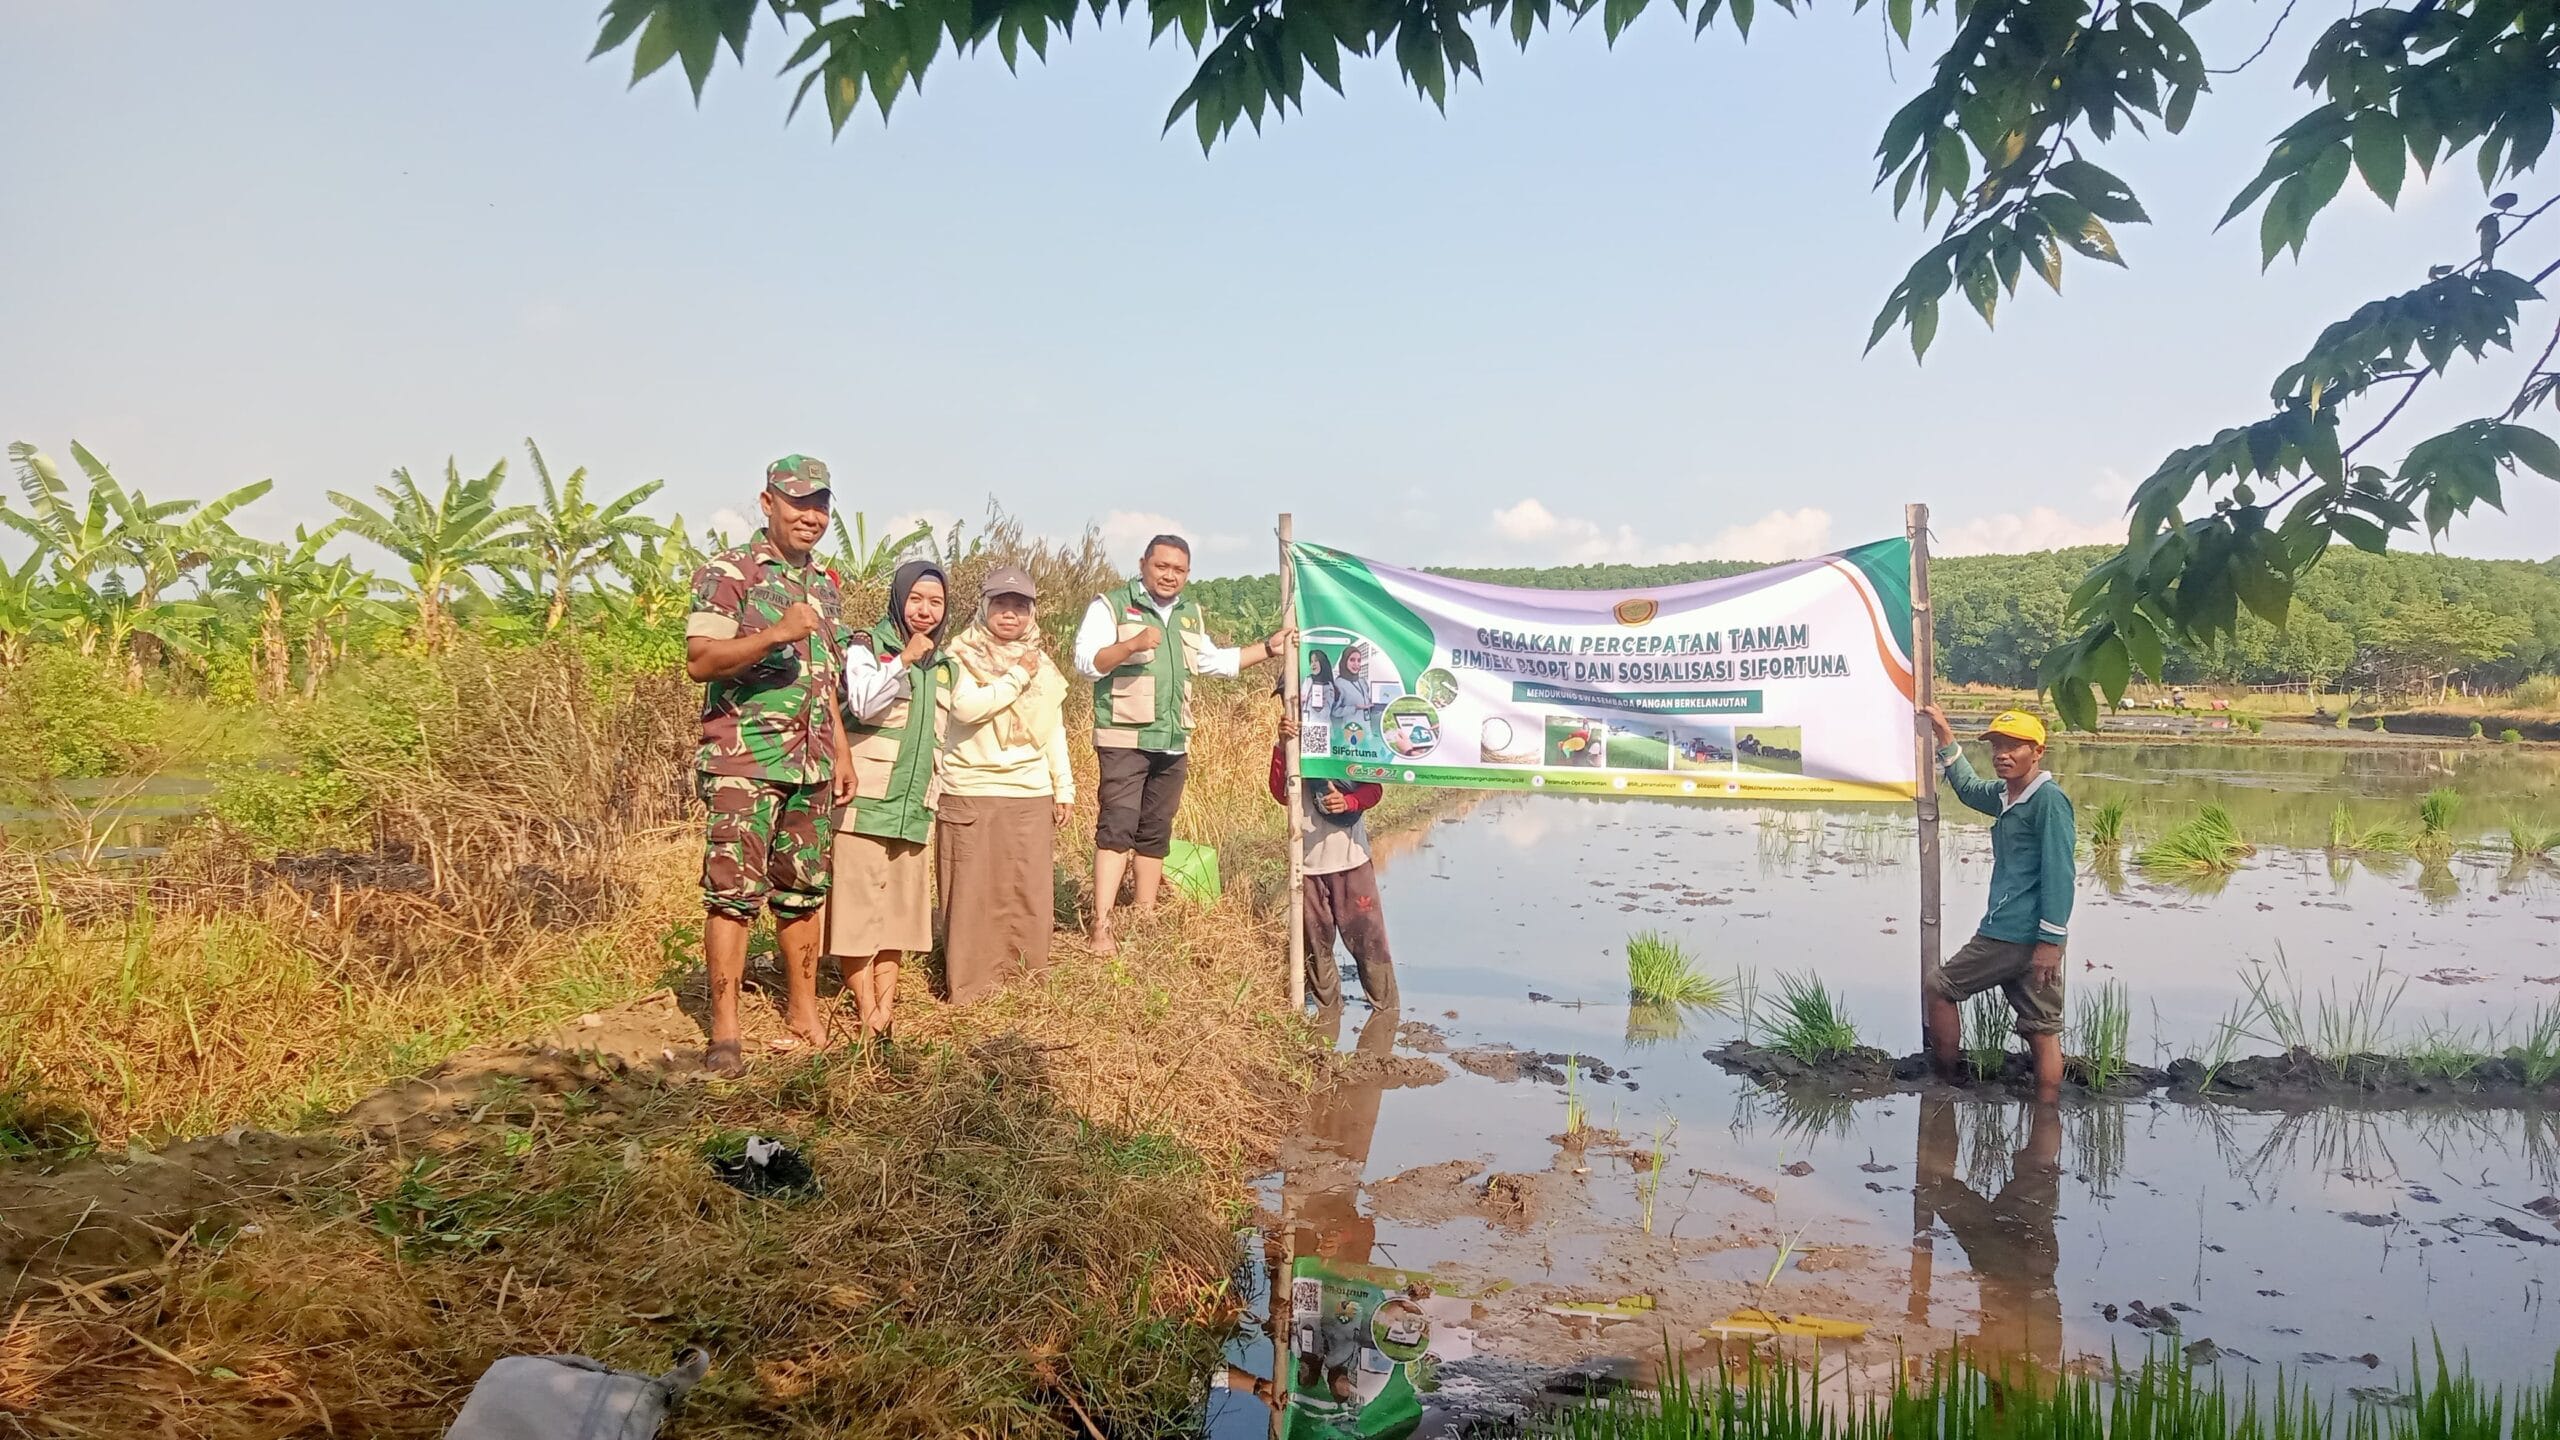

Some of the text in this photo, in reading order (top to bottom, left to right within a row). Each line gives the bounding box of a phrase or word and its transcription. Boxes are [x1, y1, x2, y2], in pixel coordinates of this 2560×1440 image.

[1477, 623, 1809, 656] GERAKAN PERCEPATAN TANAM
[1451, 648, 1850, 683] BIMTEK P3OPT DAN SOSIALISASI SIFORTUNA
[1526, 687, 1578, 701] MENDUKUNG
[1636, 698, 1673, 710] PANGAN
[1674, 696, 1748, 709] BERKELANJUTAN
[1332, 746, 1378, 758] SiFortuna
